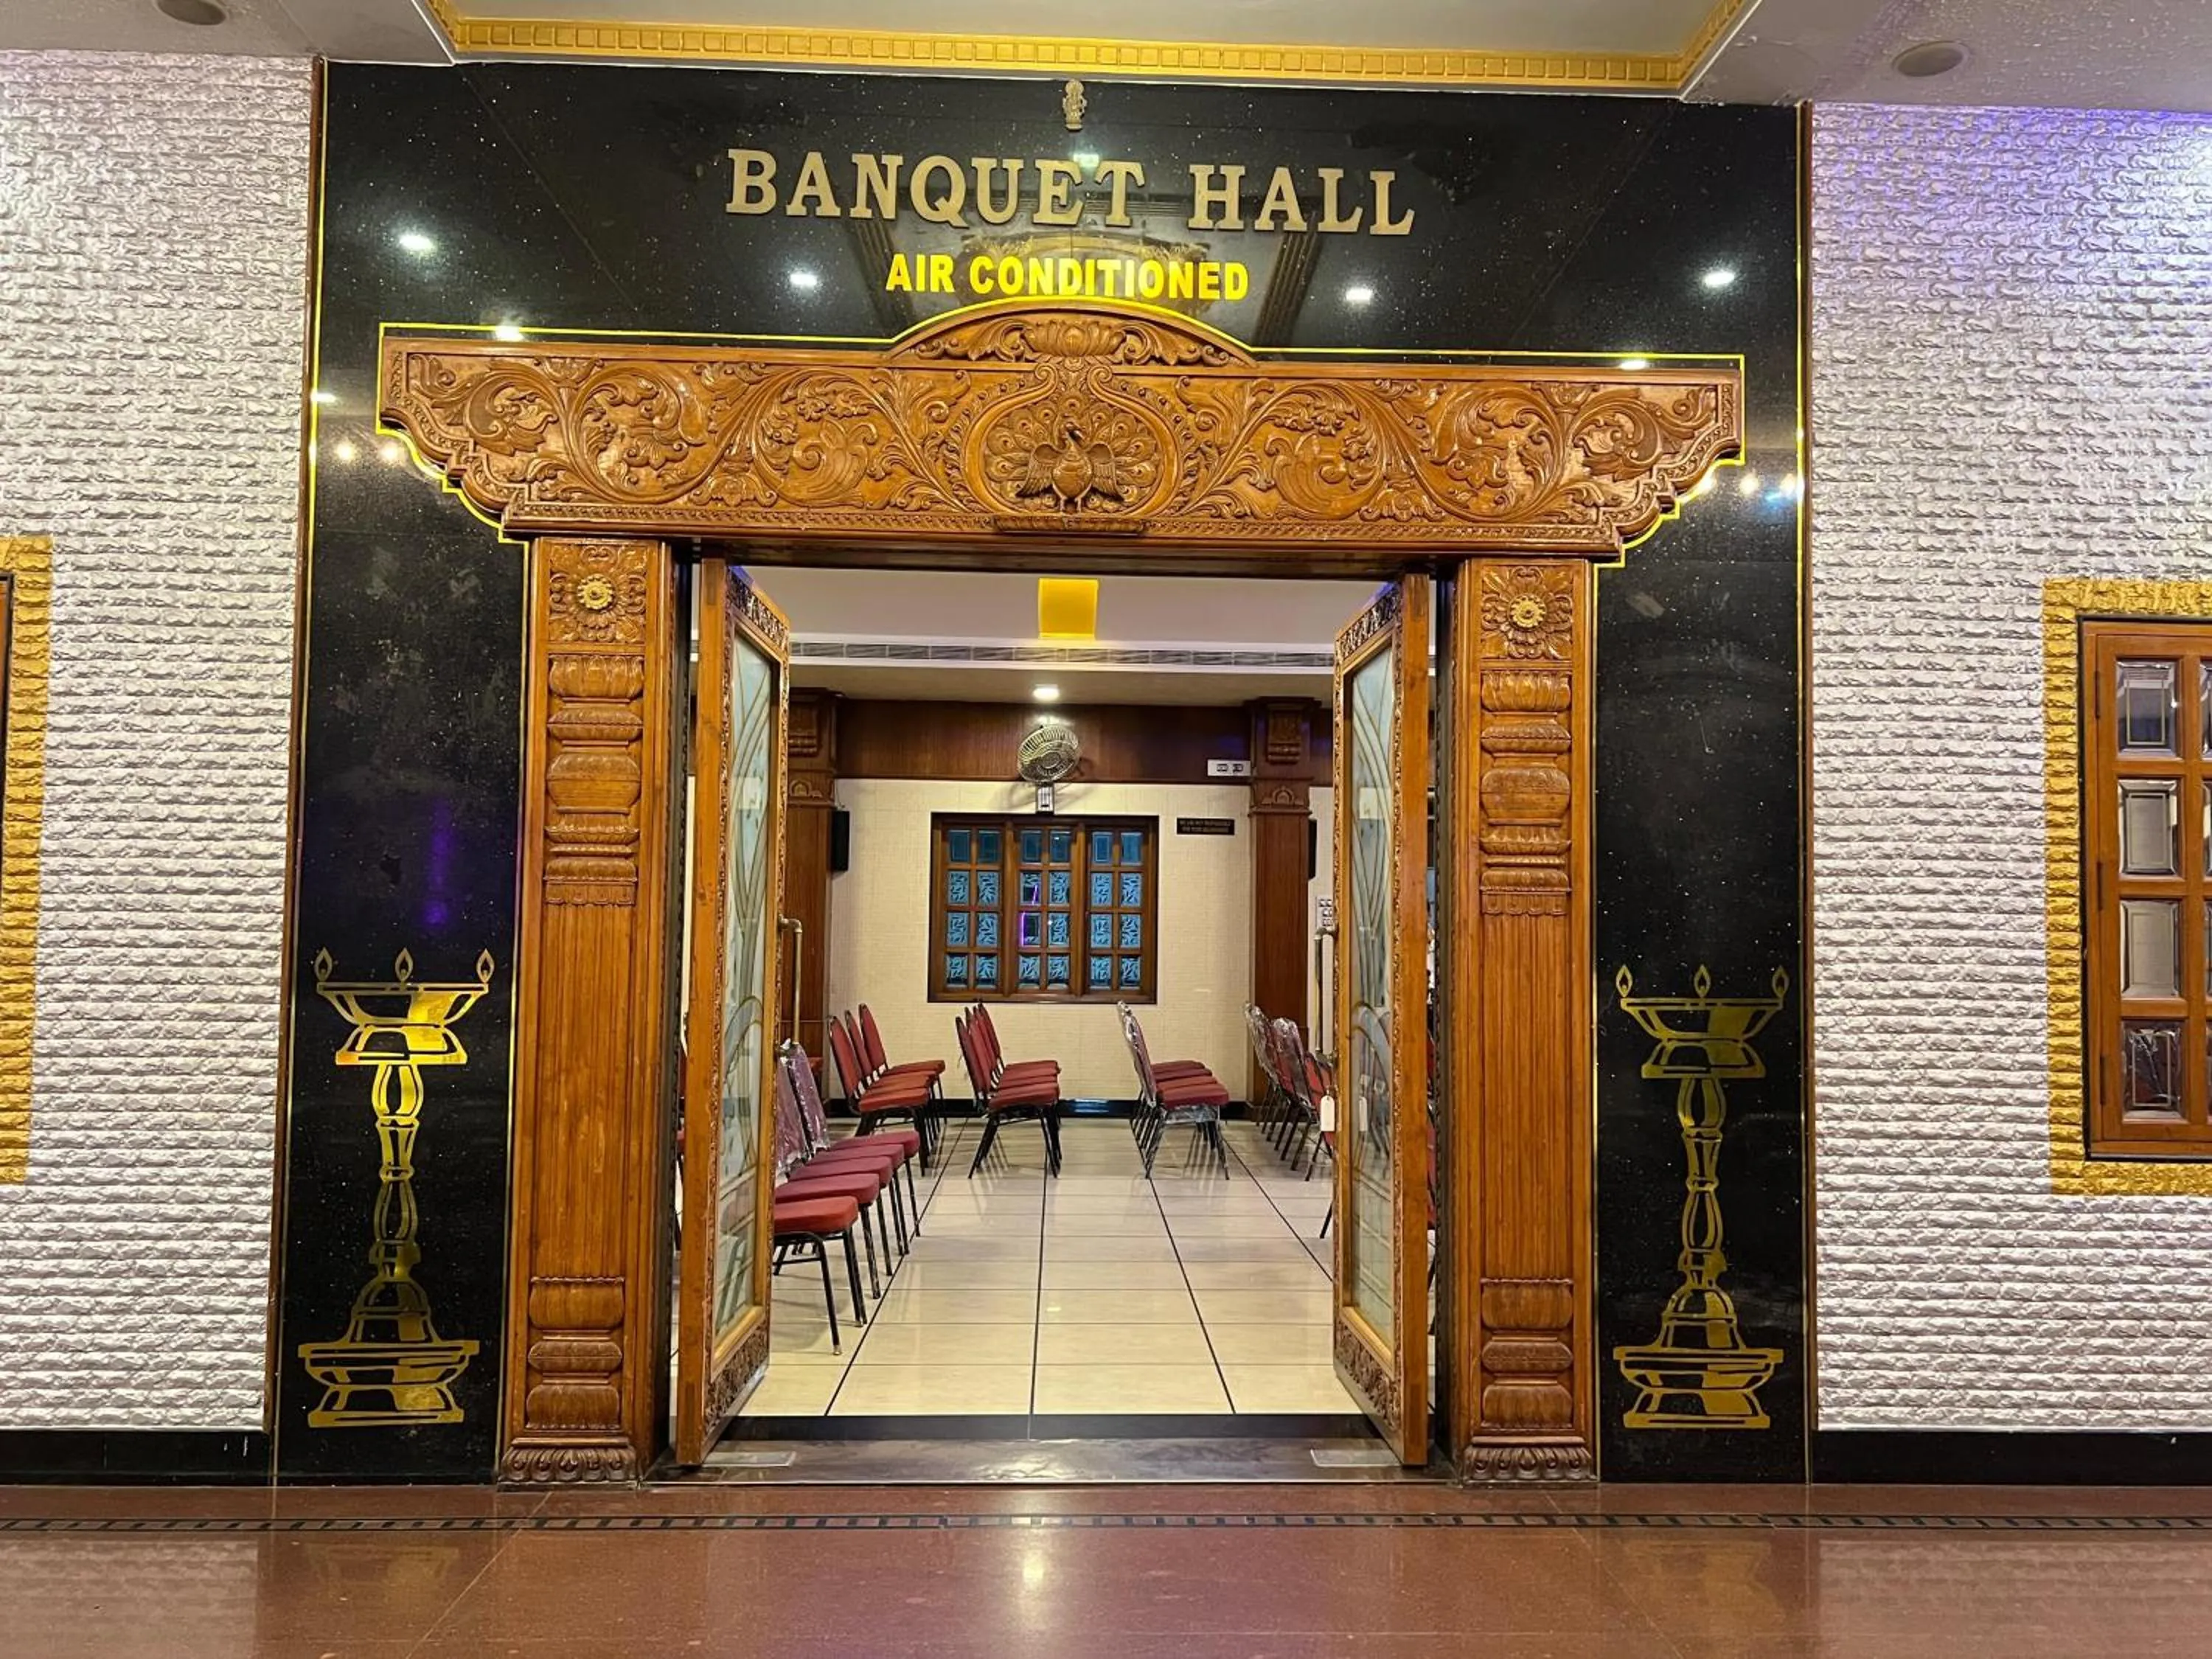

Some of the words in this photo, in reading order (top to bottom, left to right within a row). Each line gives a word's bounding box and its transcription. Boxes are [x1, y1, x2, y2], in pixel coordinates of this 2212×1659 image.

[726, 149, 1145, 229] BANQUET
[1189, 164, 1416, 235] HALL
[886, 253, 956, 293] AIR
[969, 257, 1248, 301] CONDITIONED
